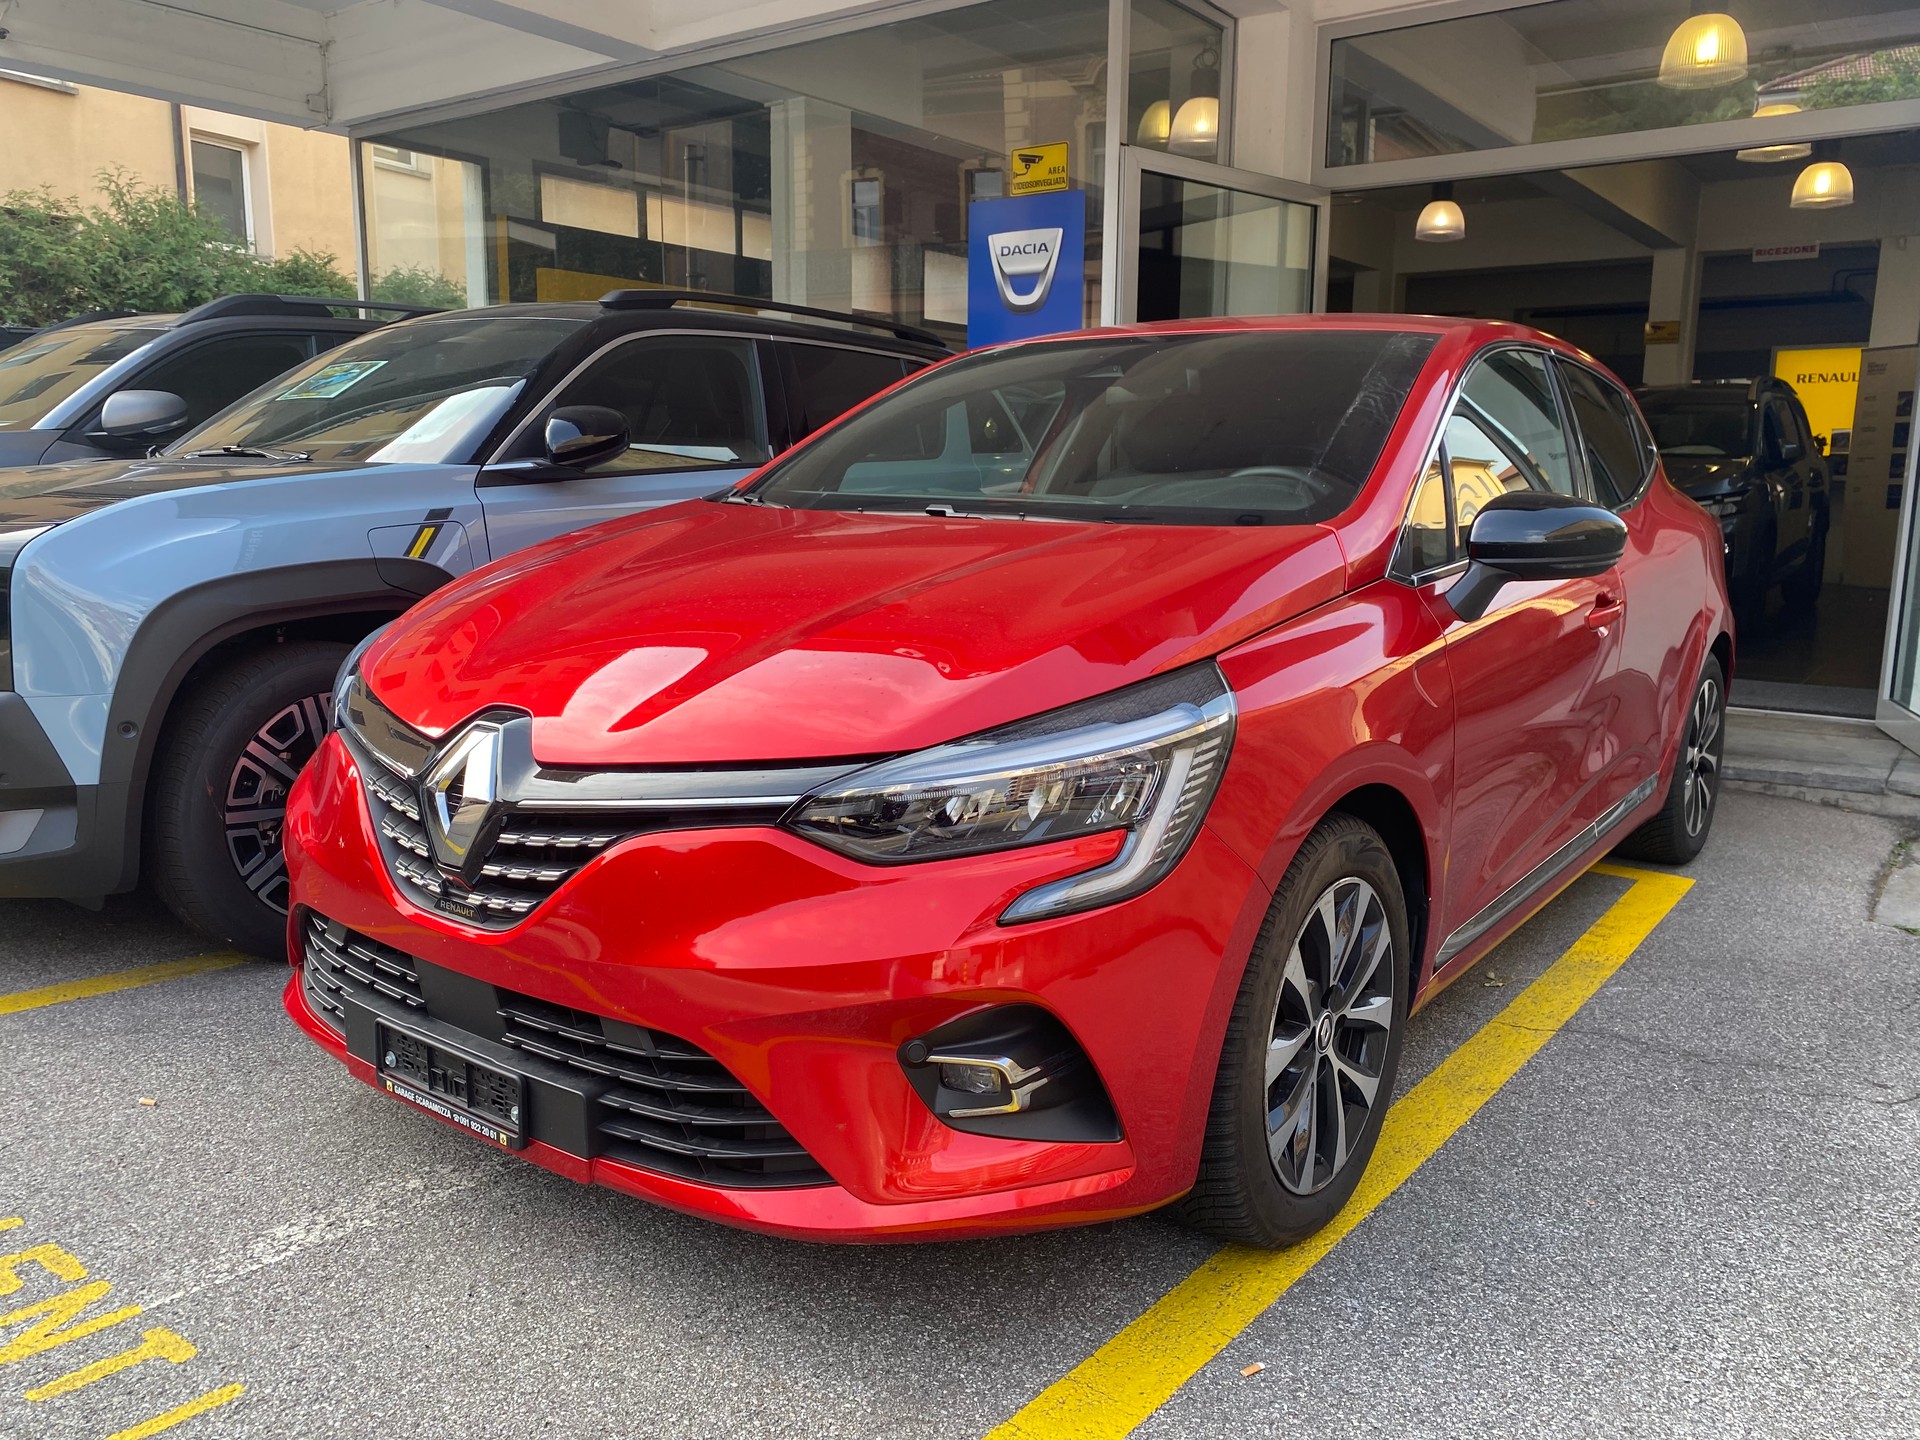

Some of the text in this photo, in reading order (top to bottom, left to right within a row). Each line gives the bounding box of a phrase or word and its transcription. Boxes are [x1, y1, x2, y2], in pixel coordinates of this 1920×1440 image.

[1048, 166, 1065, 175] AREA
[1014, 177, 1065, 189] VIDEOSORVEGLIATA
[1000, 242, 1049, 257] DACIA
[1755, 245, 1816, 256] RICEZIONE
[441, 901, 475, 917] RENAULT
[394, 1085, 415, 1102] GARAGE
[415, 1095, 452, 1119] SCARAMOZZA
[460, 1116, 469, 1127] 091
[470, 1121, 481, 1132] 922
[482, 1126, 489, 1136] 20
[0, 1217, 245, 1440] ENTI
